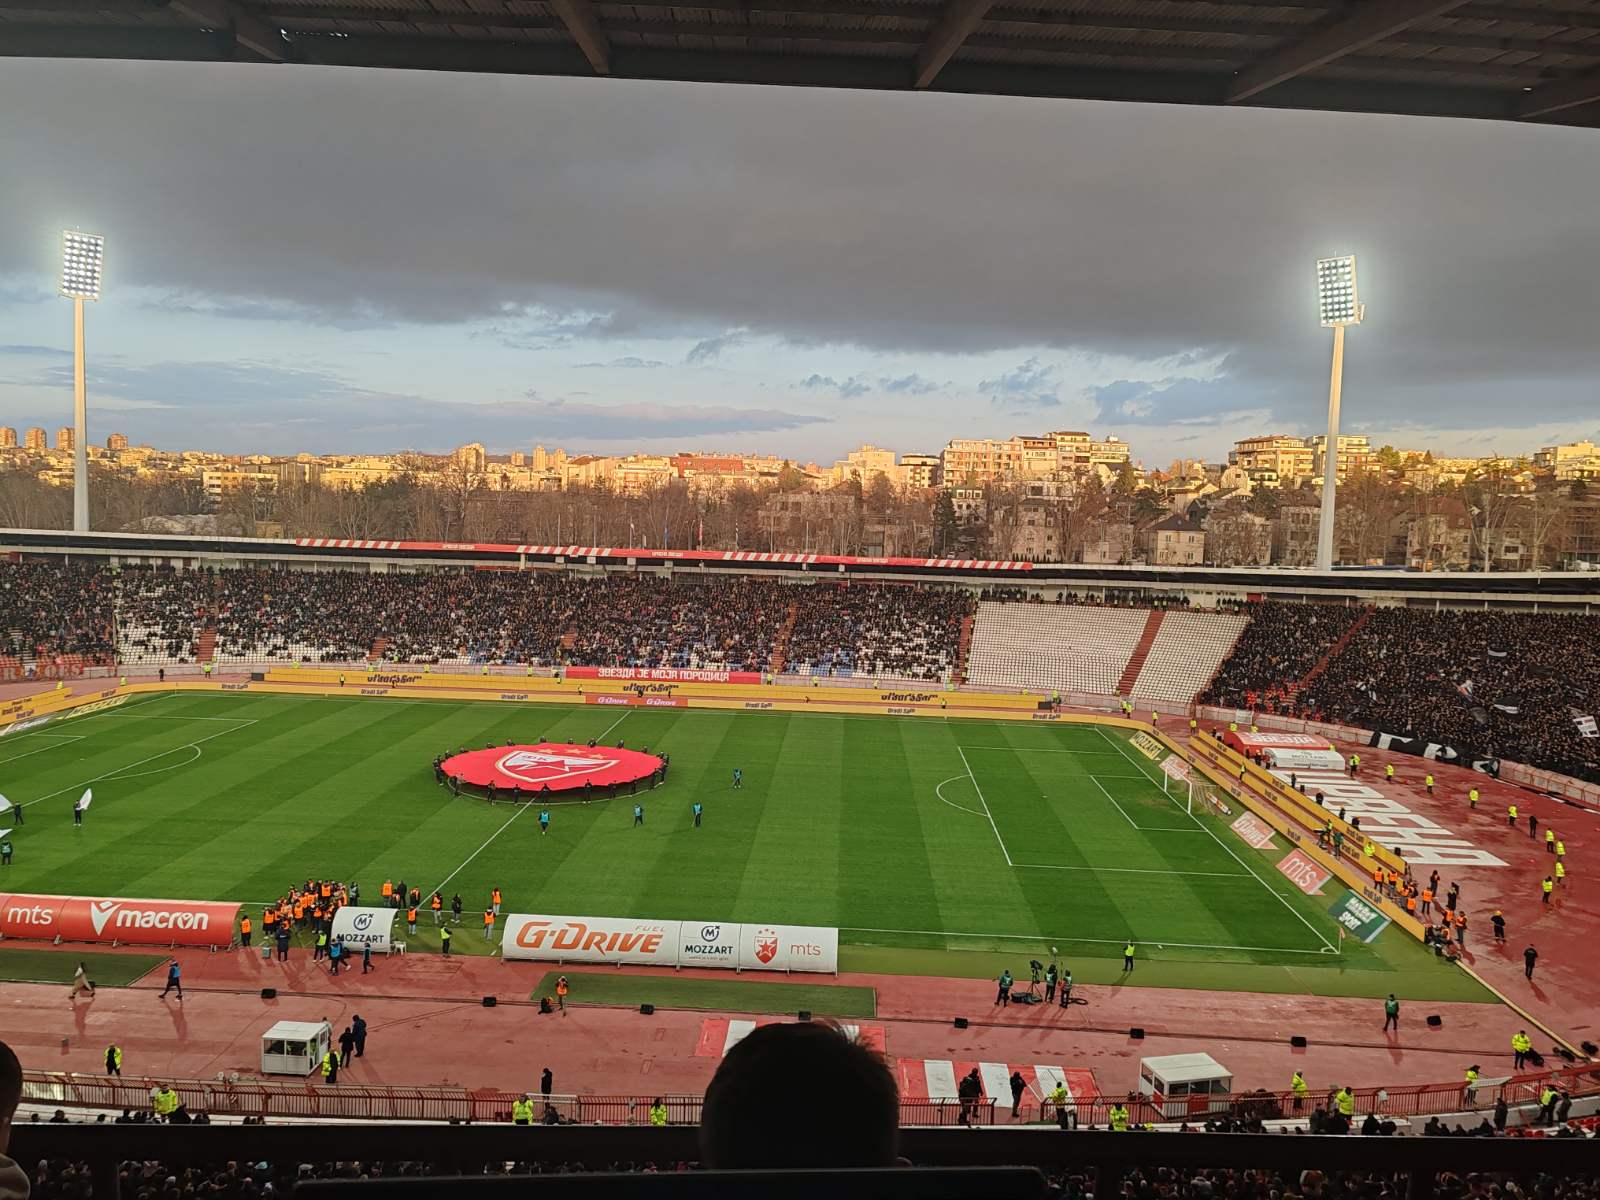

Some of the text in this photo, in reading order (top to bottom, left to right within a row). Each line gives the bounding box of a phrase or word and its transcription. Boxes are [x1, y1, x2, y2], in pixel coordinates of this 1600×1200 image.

[598, 668, 730, 682] ЗВЕЗДА ЈЕ МОЈА ПОРОДИЦА
[1282, 858, 1317, 887] mts
[7, 905, 54, 926] mts
[116, 909, 209, 931] macron
[1339, 911, 1362, 930] SPORT
[336, 933, 385, 943] MOZZART
[684, 945, 734, 955] MOZZART
[790, 943, 821, 956] mts
